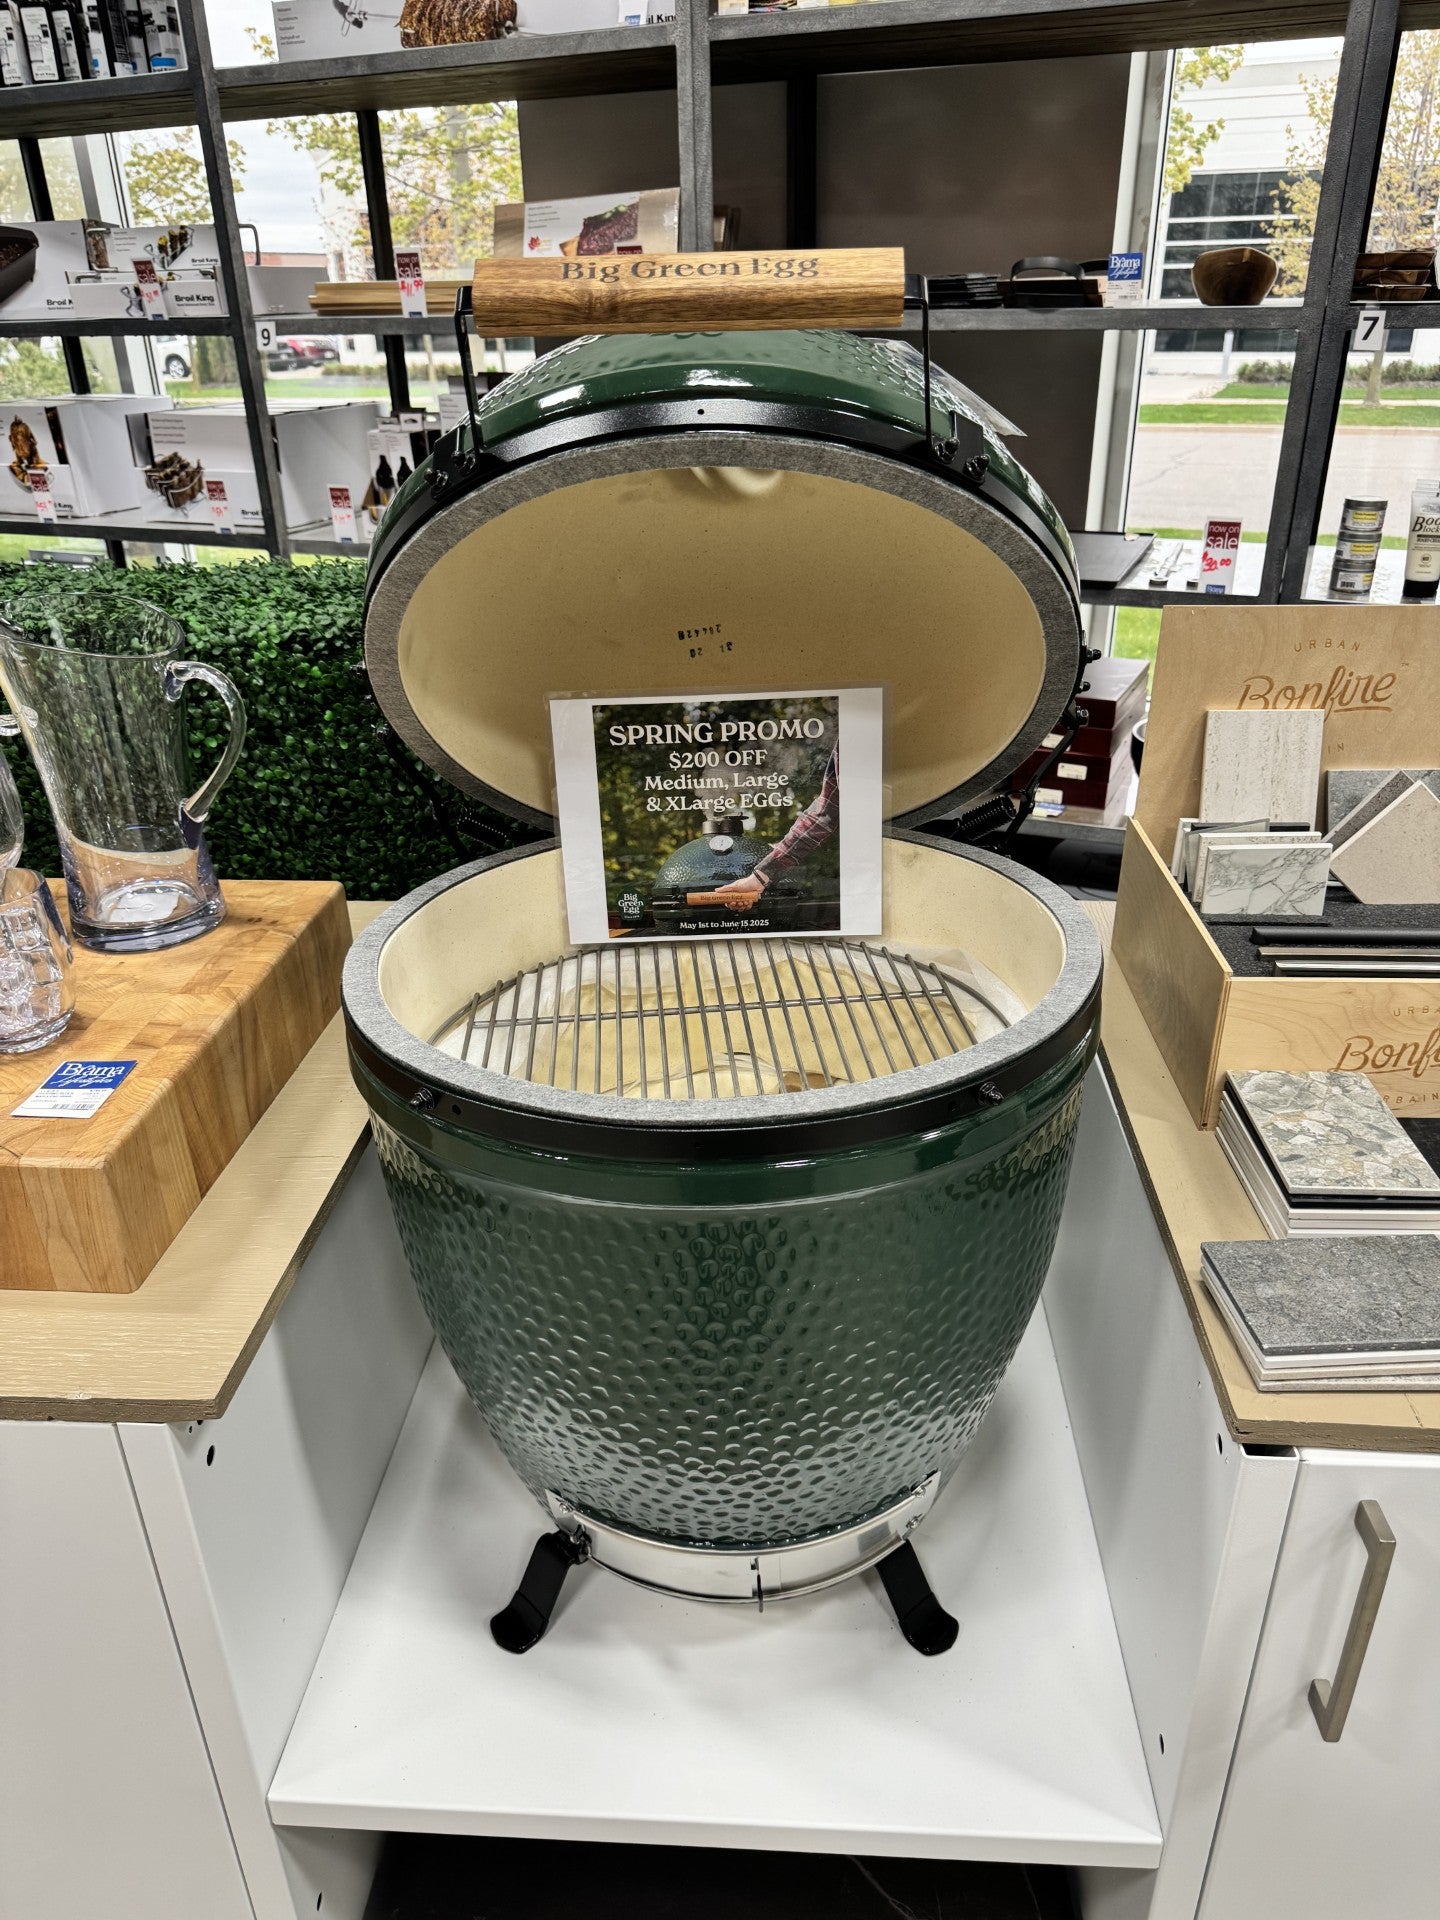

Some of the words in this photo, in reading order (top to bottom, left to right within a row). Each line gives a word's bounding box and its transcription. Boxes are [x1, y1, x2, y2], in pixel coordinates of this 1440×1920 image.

[657, 14, 676, 23] Kin
[399, 263, 421, 279] sale
[562, 262, 621, 283] Big
[631, 260, 741, 279] Green
[751, 257, 819, 278] Egg
[196, 295, 215, 303] King
[1361, 316, 1380, 341] 7
[261, 328, 271, 347] 9
[1207, 533, 1237, 550] sale
[1294, 639, 1361, 652] URBAN
[1236, 665, 1397, 722] Bonfire
[609, 723, 713, 746] SPRING
[720, 717, 825, 742] PROMO
[669, 751, 720, 770] $200
[724, 750, 768, 767] OFF
[645, 774, 729, 791] Medium,
[733, 773, 790, 789] Large
[646, 799, 662, 812] &
[665, 797, 736, 813] XLarge
[740, 793, 794, 808] EGGs
[618, 899, 644, 907] Green
[623, 893, 638, 901] Big
[623, 906, 640, 914] Egg
[680, 922, 697, 930] May
[720, 920, 739, 928] June
[741, 919, 749, 927] 15
[750, 919, 770, 927] 2025
[58, 1063, 125, 1077] Brama
